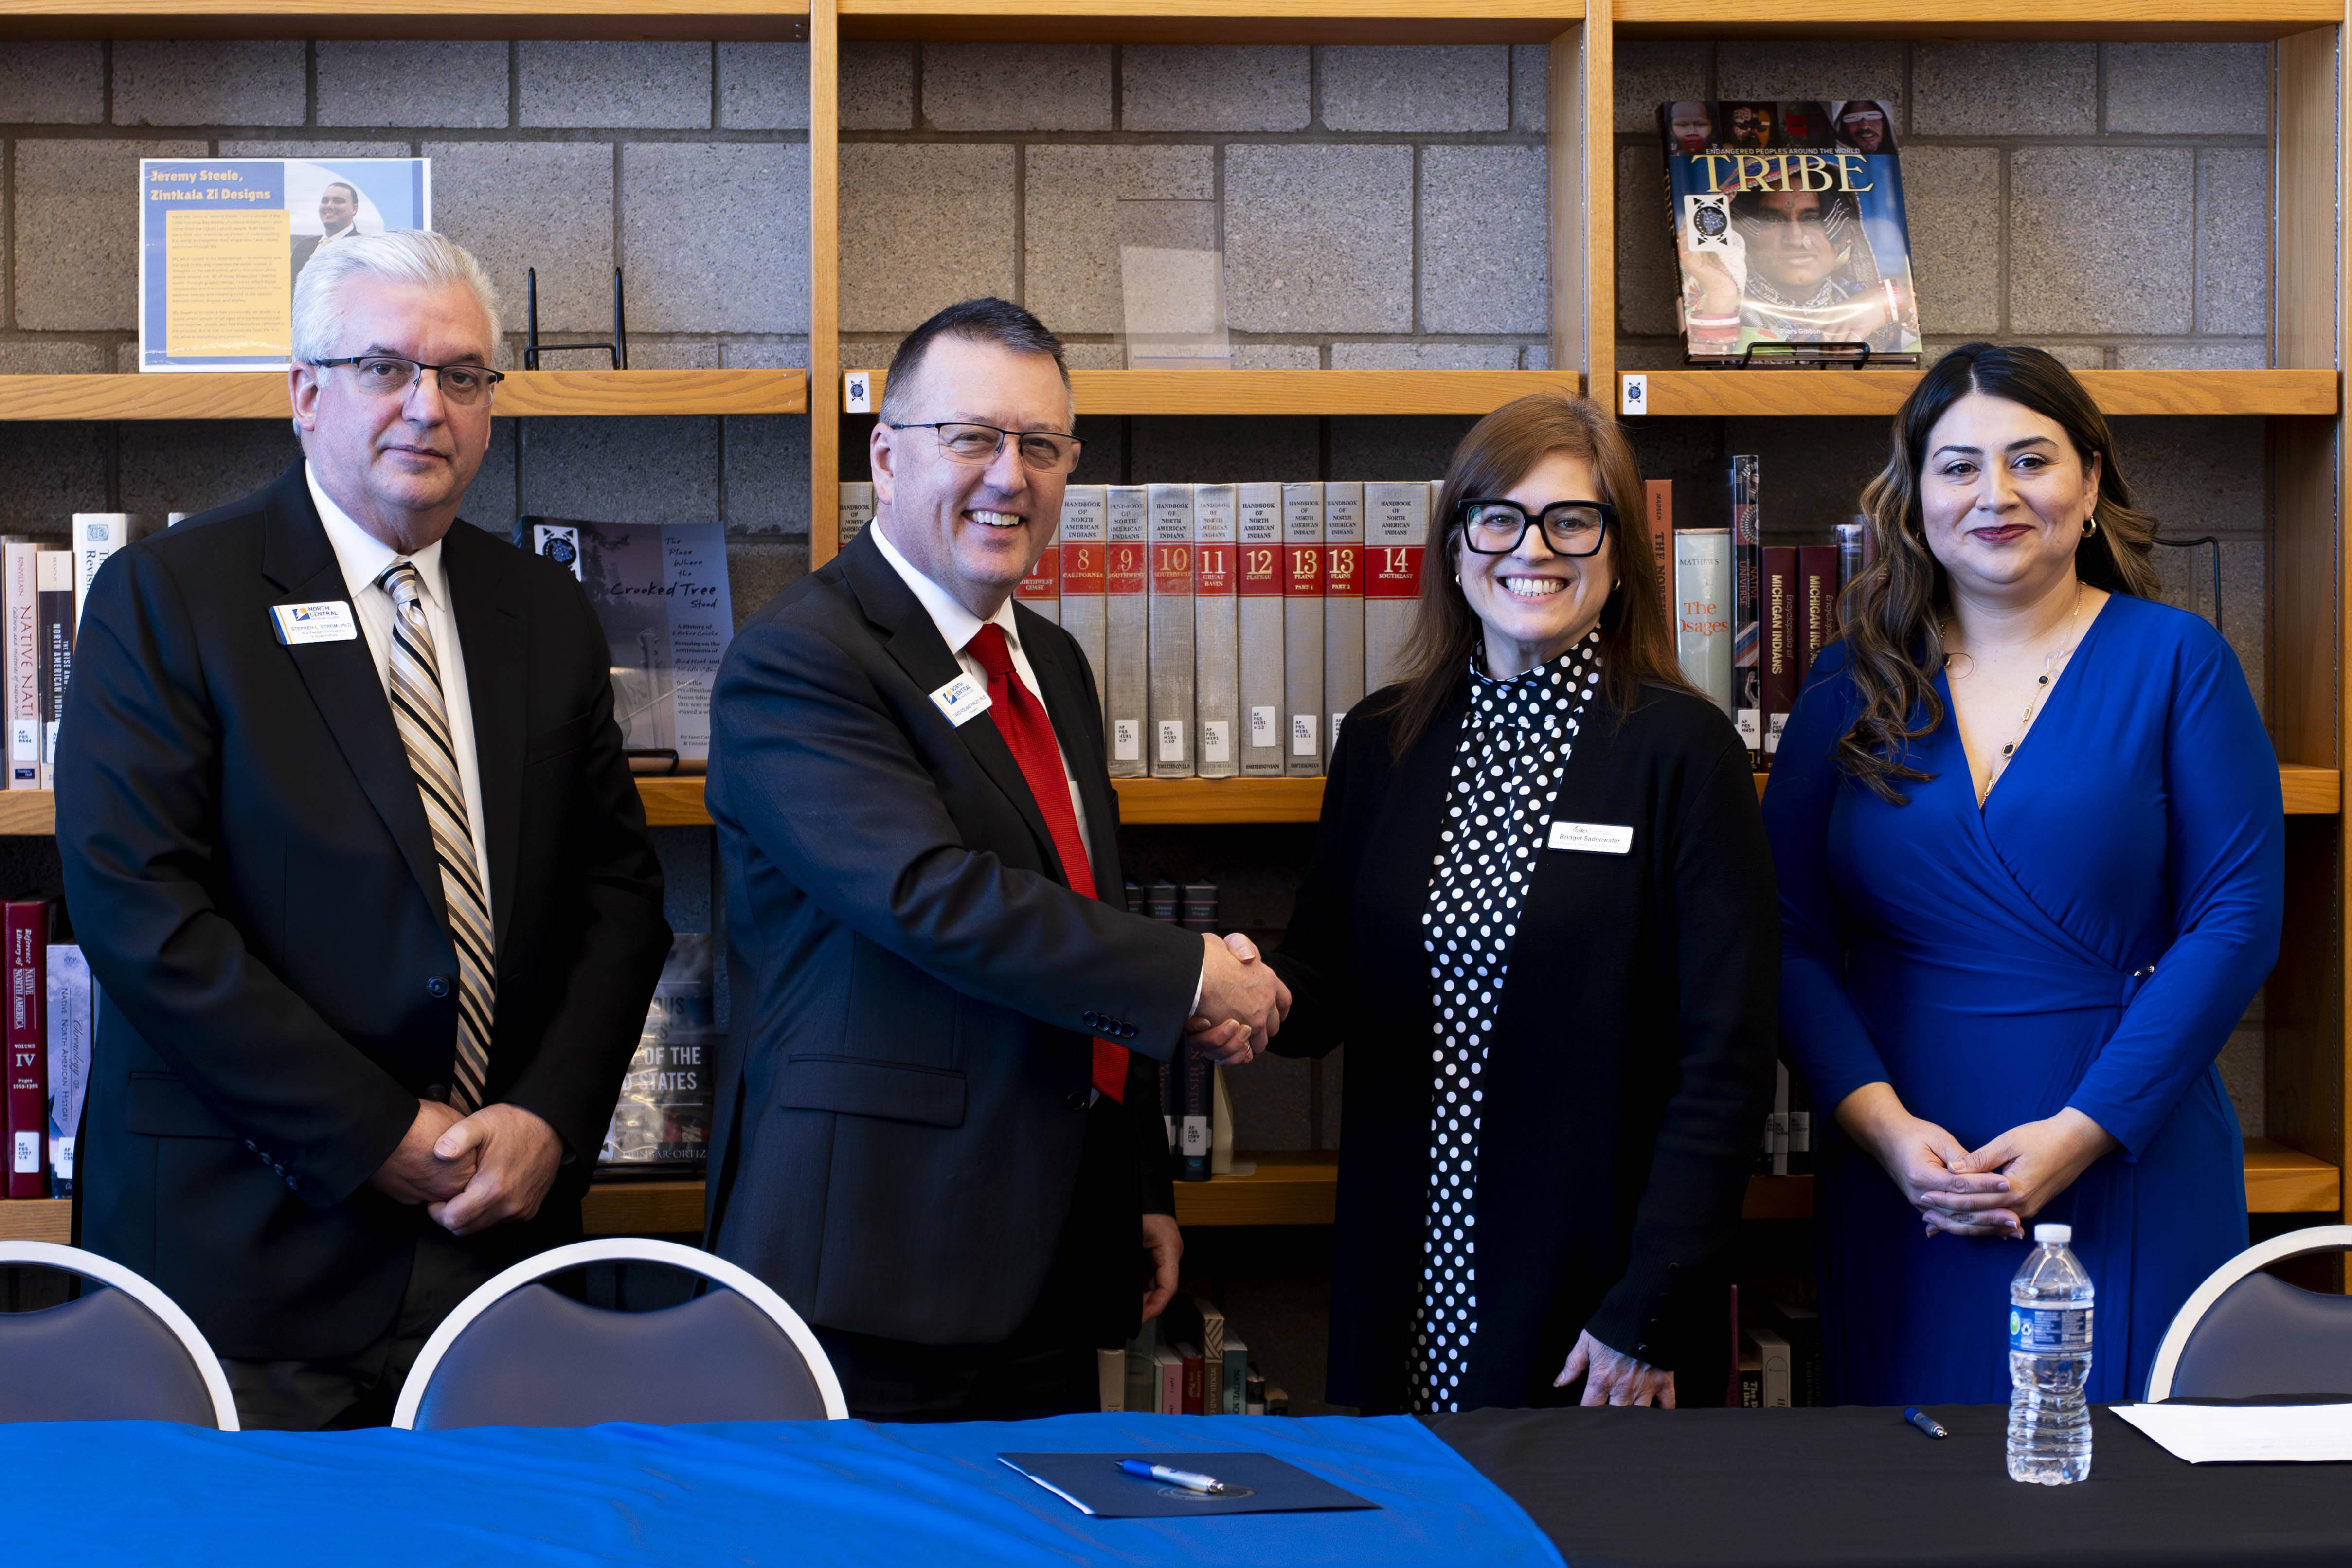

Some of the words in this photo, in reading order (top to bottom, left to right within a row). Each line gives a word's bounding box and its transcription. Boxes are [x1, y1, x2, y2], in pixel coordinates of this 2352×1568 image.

[150, 171, 197, 184] Jeremy
[199, 170, 243, 182] Steele,
[1690, 154, 1874, 192] TRIBE
[151, 189, 204, 200] Zintkala
[206, 189, 218, 200] Zi
[221, 188, 271, 202] Designs
[1654, 531, 1665, 560] THE
[1077, 549, 1089, 570] 8
[1120, 549, 1132, 572] 9
[1160, 548, 1188, 571] 10
[1201, 550, 1226, 574] 11
[1246, 550, 1273, 575] 12
[1292, 550, 1317, 574] 13
[1329, 549, 1354, 574] 13
[1383, 548, 1409, 573] 14
[677, 569, 692, 577] the
[1739, 560, 1747, 605] UNIVERSE
[610, 581, 678, 598] Crooked
[679, 583, 716, 597] Tree
[1771, 574, 1783, 628] MICHIGAN
[691, 599, 718, 609] Stood
[1684, 601, 1717, 615] The
[1809, 576, 1821, 629] MICHIGAN
[1785, 594, 1794, 649] Encyclopedia
[20, 606, 33, 667] NATIVE
[53, 623, 61, 649] NORTH
[1771, 631, 1783, 674] INDIANS
[54, 652, 62, 692] AMERICAN
[950, 681, 964, 692] NORTH
[954, 685, 972, 697] CENTRAL
[1583, 835, 1621, 844] Sadenwater
[24, 928, 32, 964] Reference
[15, 968, 23, 995] NORTH
[25, 968, 34, 995] NATIVE
[16, 996, 24, 1030] AMERICA
[16, 1053, 36, 1067] IV
[644, 1047, 664, 1065] OF
[670, 1047, 701, 1065] THE
[639, 1072, 697, 1090] STATES
[1233, 1370, 1241, 1400] NATIVE
